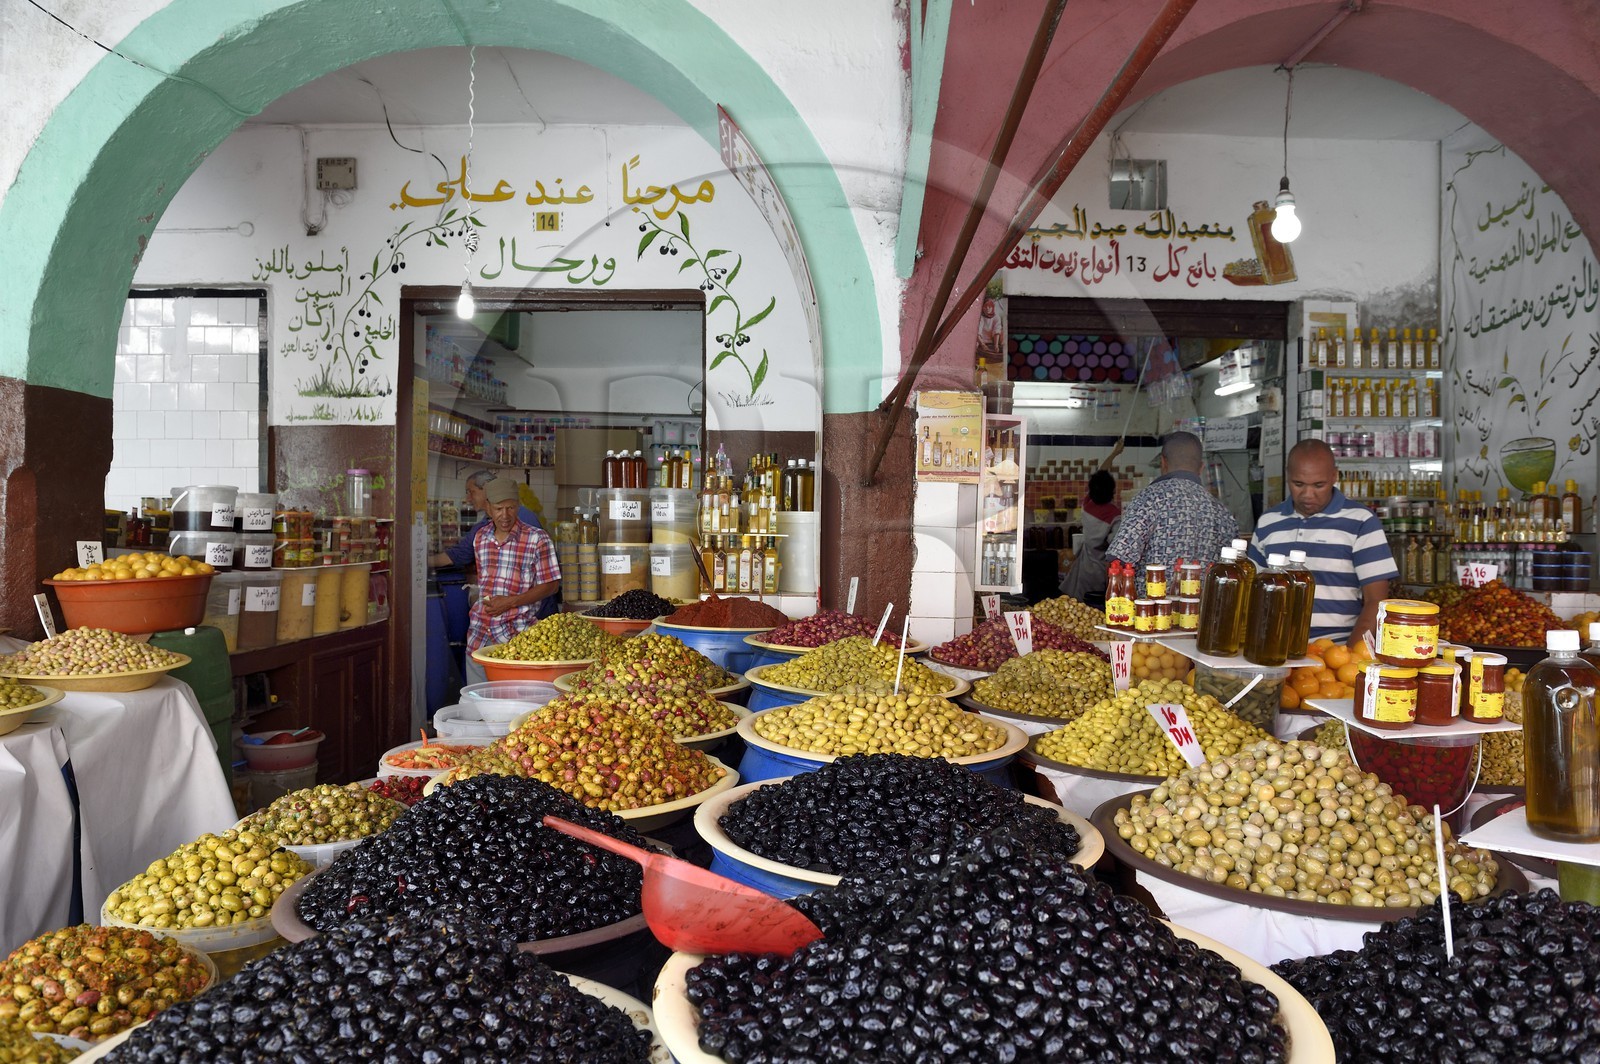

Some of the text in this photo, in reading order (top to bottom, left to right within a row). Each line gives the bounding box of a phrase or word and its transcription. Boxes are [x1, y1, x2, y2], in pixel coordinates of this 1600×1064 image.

[389, 154, 516, 211] علي
[525, 177, 594, 206] عند
[539, 213, 555, 229] 14
[1025, 203, 1086, 242] المجي
[1090, 221, 1127, 240] عبد
[252, 243, 349, 282] أملو باللوز
[1039, 248, 1079, 278] زيوت
[1080, 239, 1121, 286] أنواع
[1125, 255, 1147, 273] 13
[1152, 242, 1217, 288] بائع كل
[295, 273, 351, 303] السمن
[364, 313, 396, 345] الخليع
[301, 339, 319, 361] زيت
[1463, 369, 1497, 398] الخليع
[1463, 567, 1473, 577] 2
[1474, 566, 1486, 578] 16
[988, 597, 996, 608] 16
[1013, 613, 1024, 626] 16
[1015, 627, 1029, 641] DH
[1115, 662, 1128, 679] DH
[1160, 706, 1178, 726] 16
[1168, 726, 1194, 748] DH
